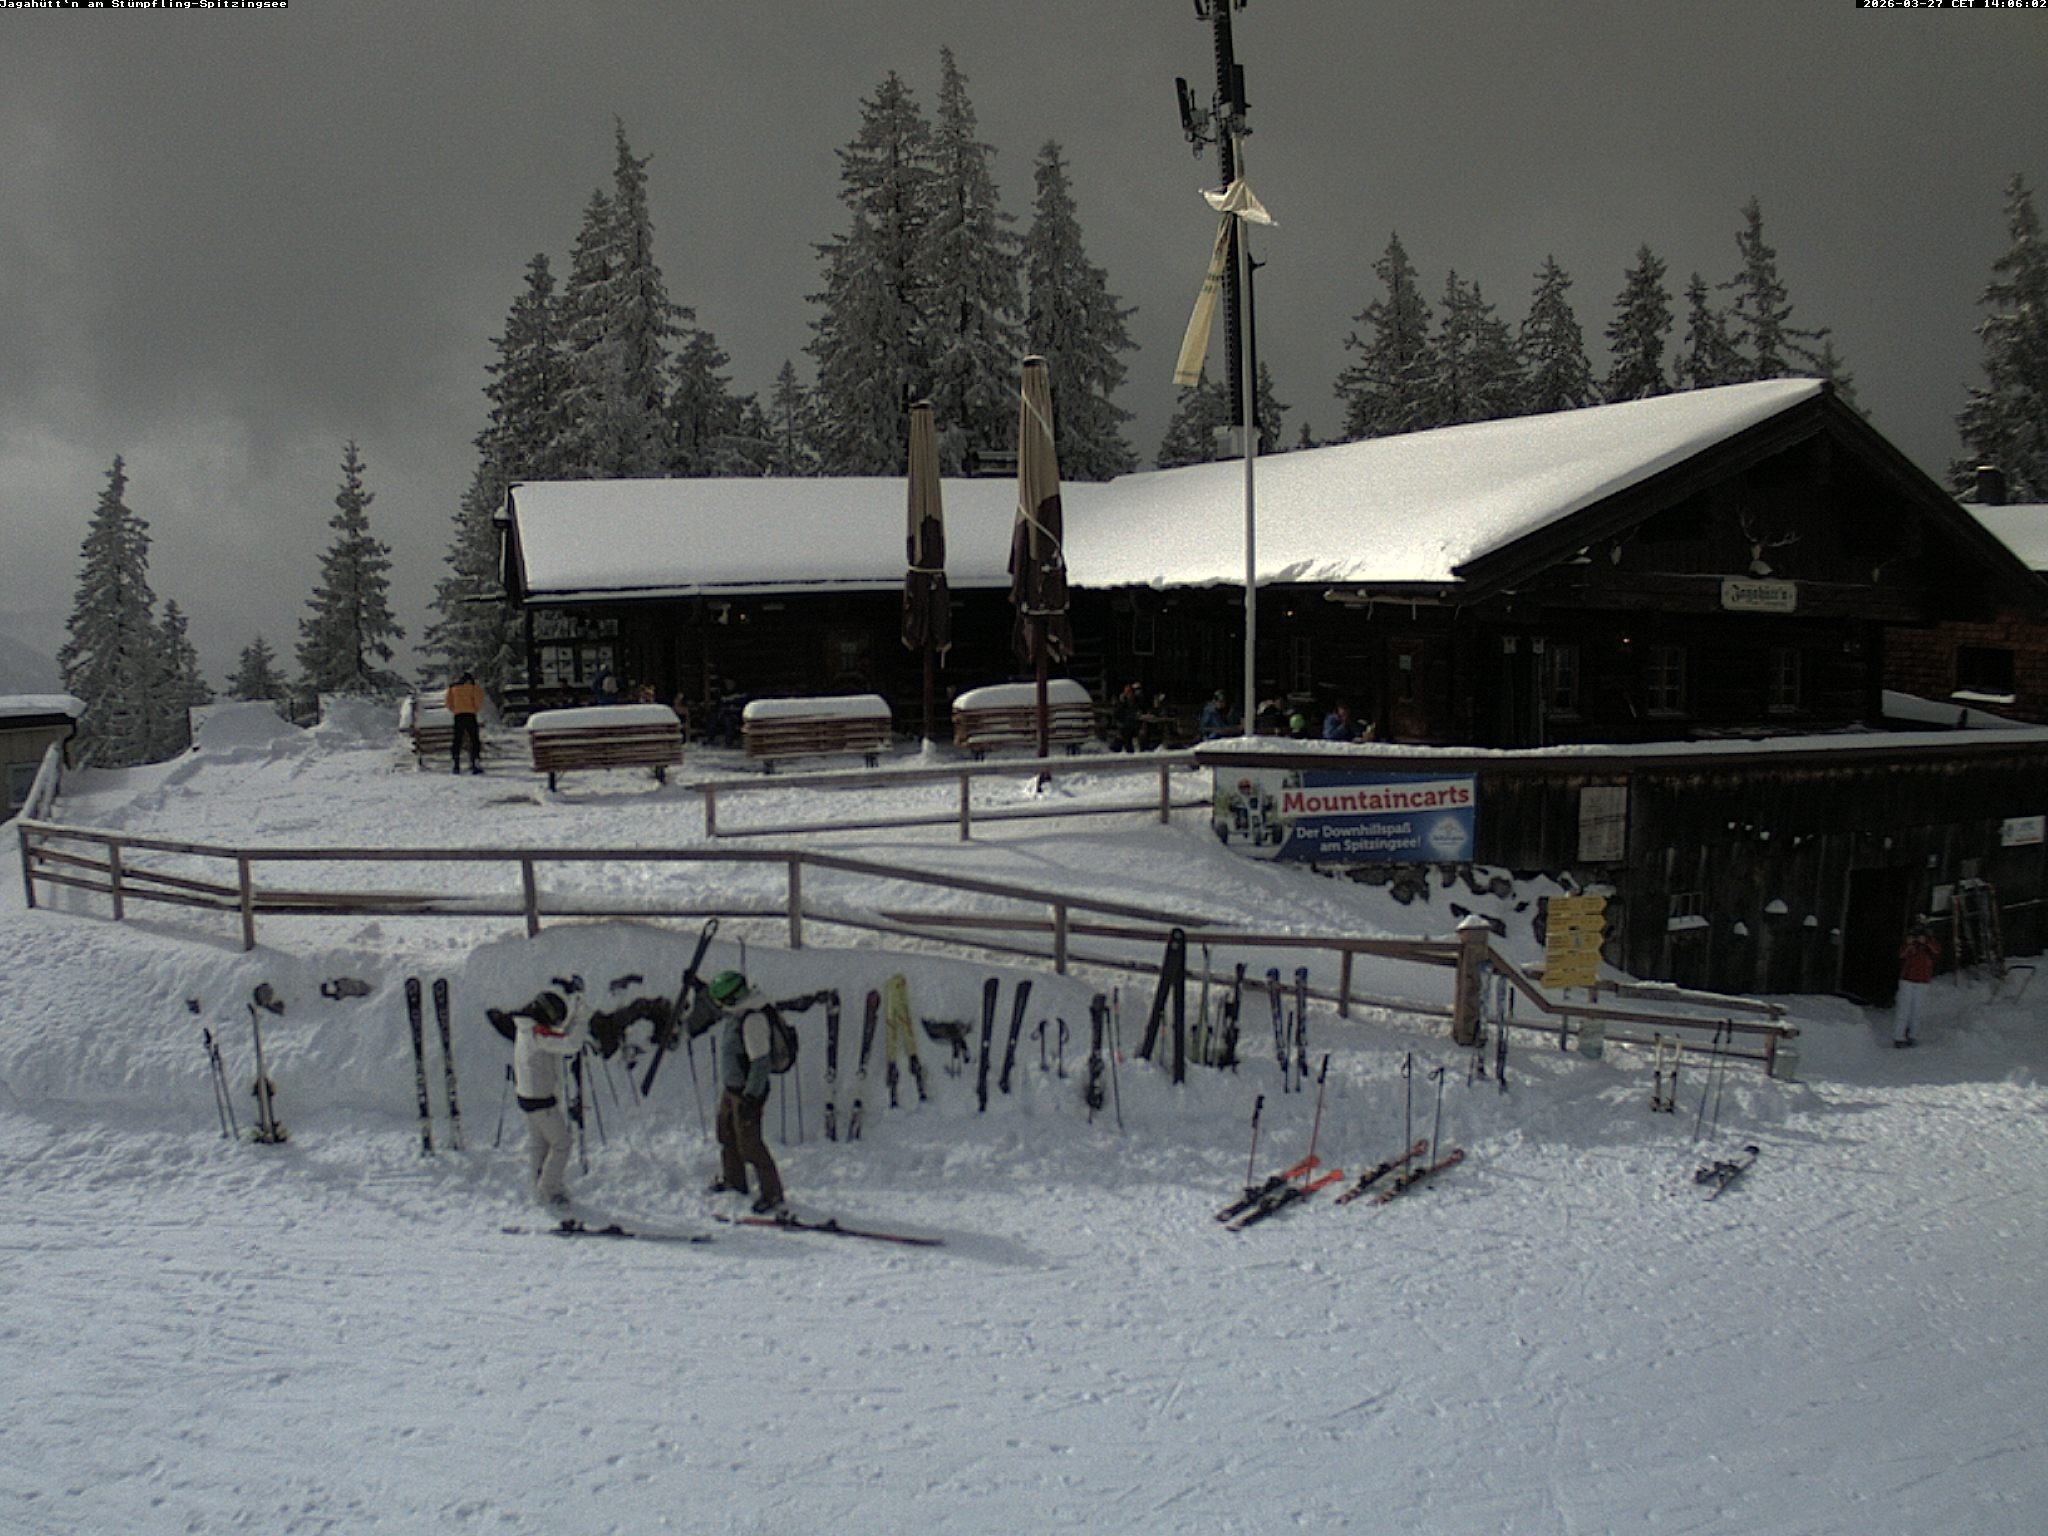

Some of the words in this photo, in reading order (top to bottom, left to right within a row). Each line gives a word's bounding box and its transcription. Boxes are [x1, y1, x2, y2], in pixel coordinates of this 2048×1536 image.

[1282, 786, 1469, 813] Mountaincarts
[1296, 827, 1319, 839] Der
[1322, 822, 1412, 838] Downhillspaß
[1320, 842, 1341, 852] am
[1343, 836, 1421, 853] Spitzingsee!
